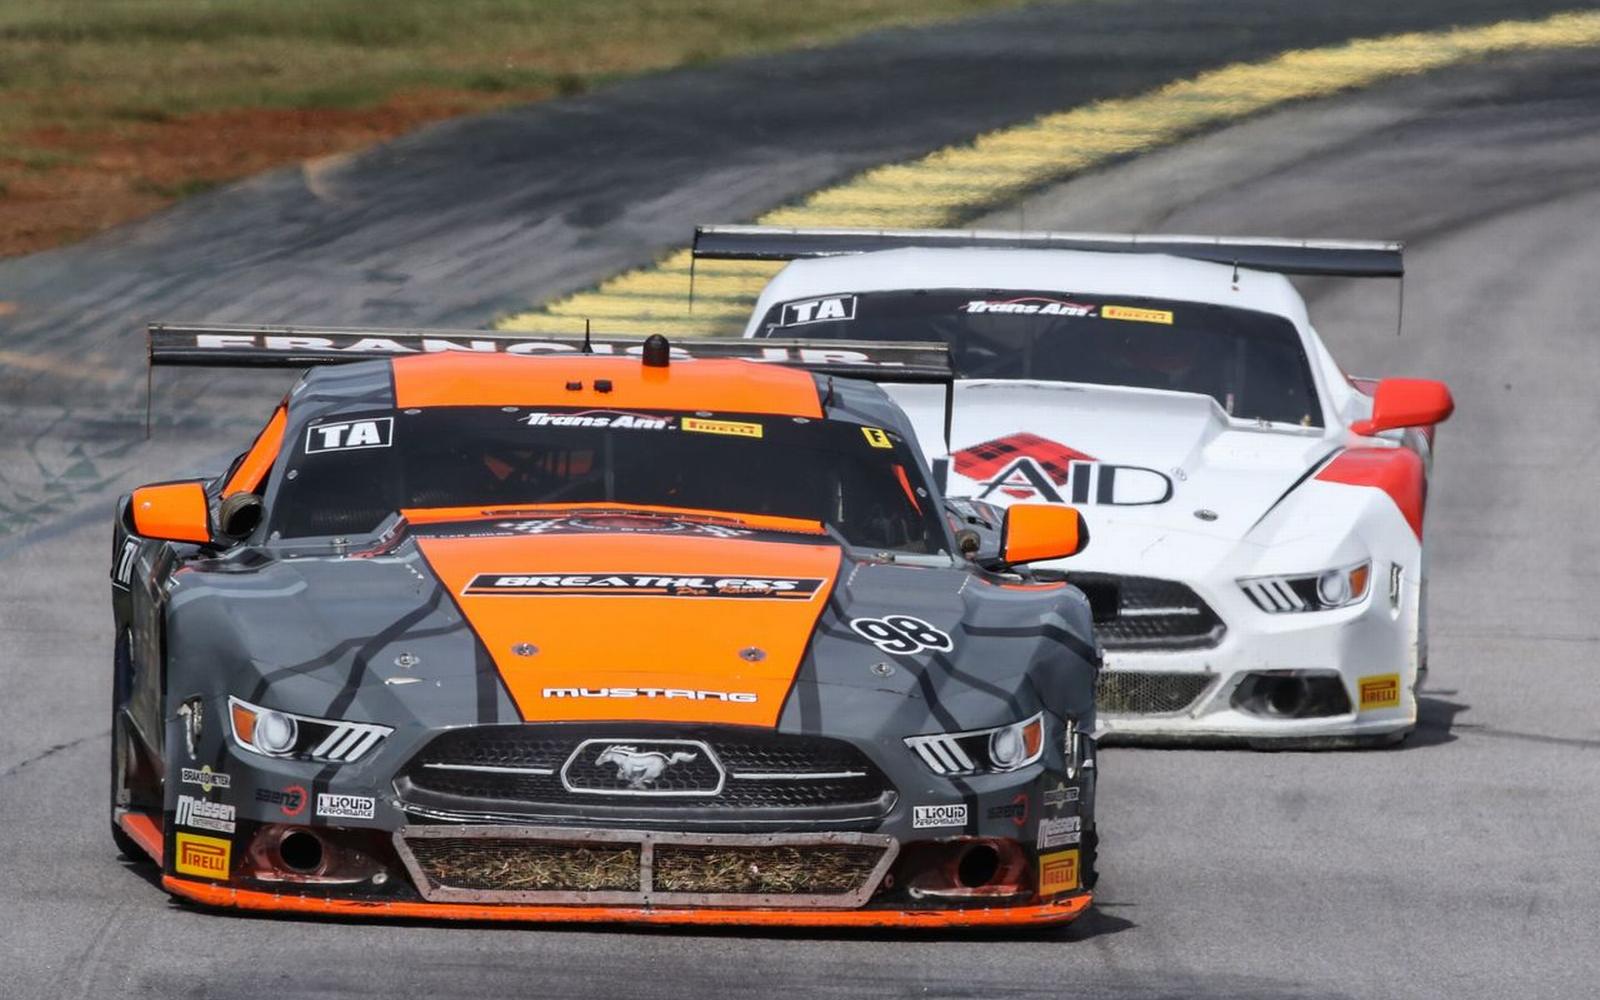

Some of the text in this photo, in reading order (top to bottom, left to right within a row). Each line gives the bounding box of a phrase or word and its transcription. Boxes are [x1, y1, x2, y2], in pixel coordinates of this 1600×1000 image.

[791, 298, 846, 322] TA
[966, 300, 1040, 315] Trans
[1108, 308, 1168, 321] PIRELLI
[526, 412, 610, 428] Trans
[689, 419, 756, 435] PIRELLI
[317, 421, 381, 449] TA
[493, 575, 800, 591] BREATHLESS
[850, 614, 954, 656] 98
[541, 687, 759, 703] MUSTANG
[1361, 679, 1397, 704] PIRELLI
[182, 840, 226, 872] PIRELLI
[1042, 857, 1075, 886] PIRELLI
